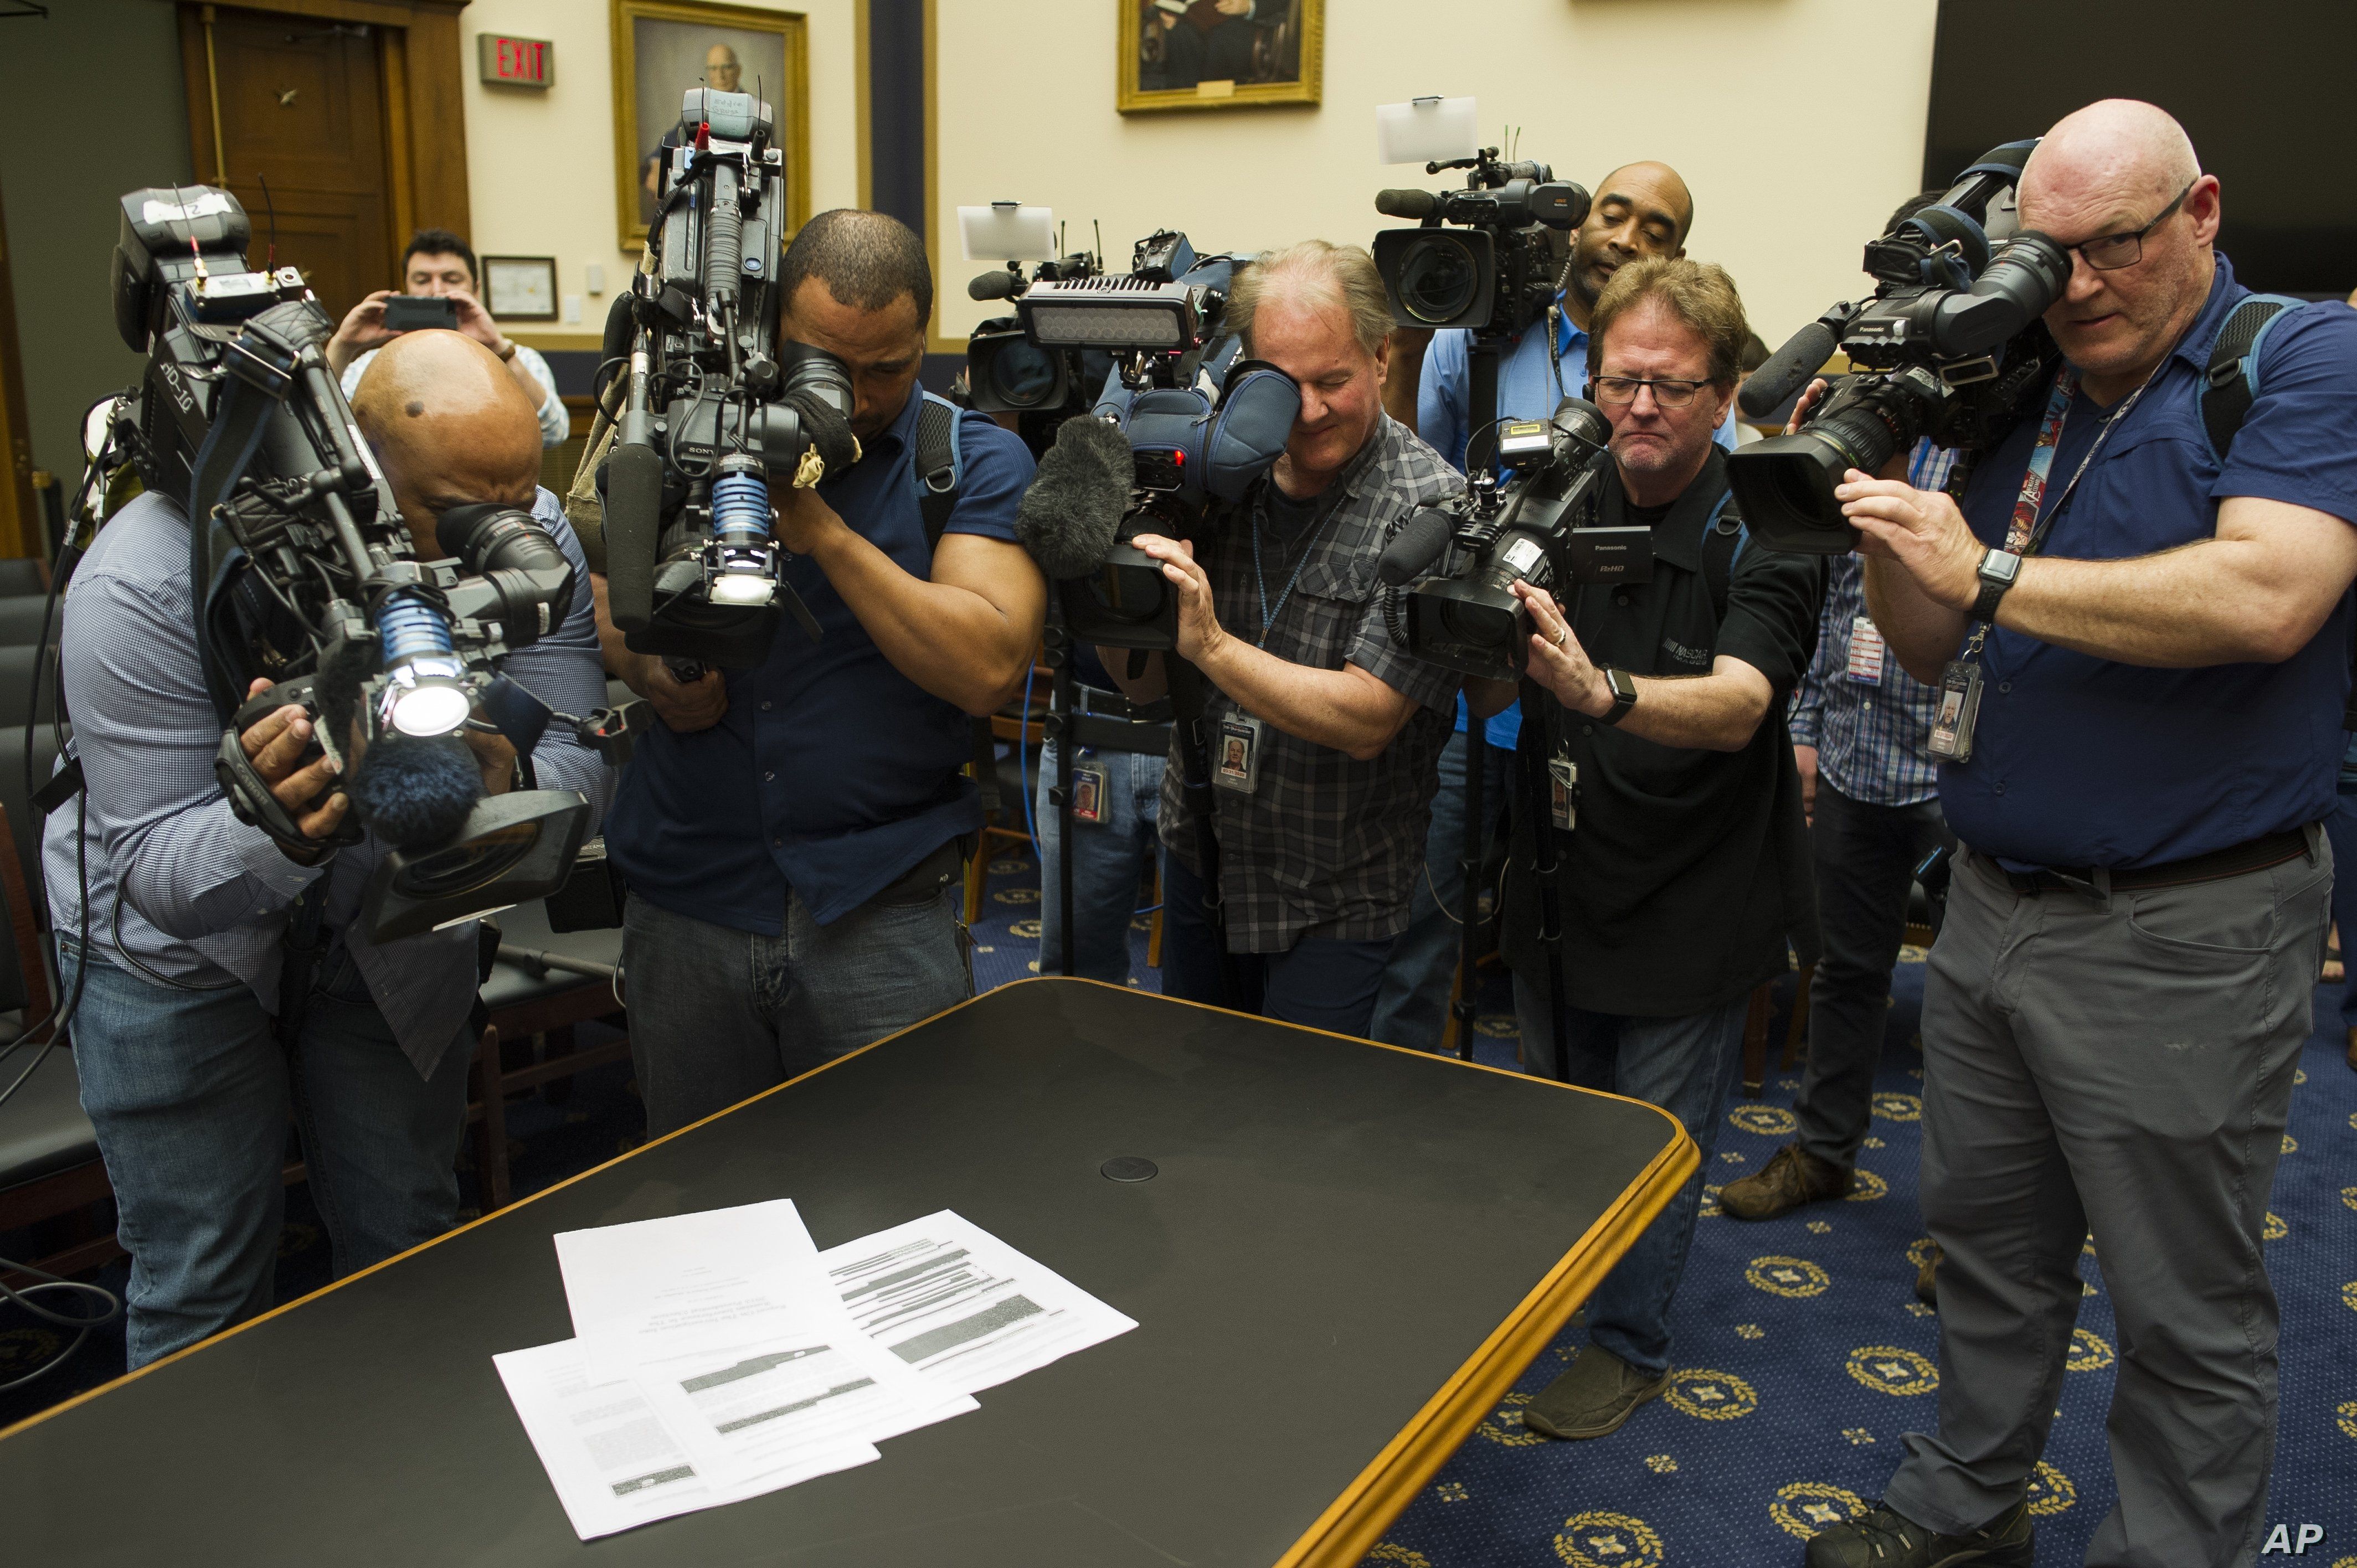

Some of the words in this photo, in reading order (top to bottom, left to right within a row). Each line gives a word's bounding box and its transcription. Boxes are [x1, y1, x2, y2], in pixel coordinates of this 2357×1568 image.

[496, 38, 545, 81] EXIT
[1672, 654, 1707, 665] IMAGES
[1676, 645, 1708, 660] NASCAR
